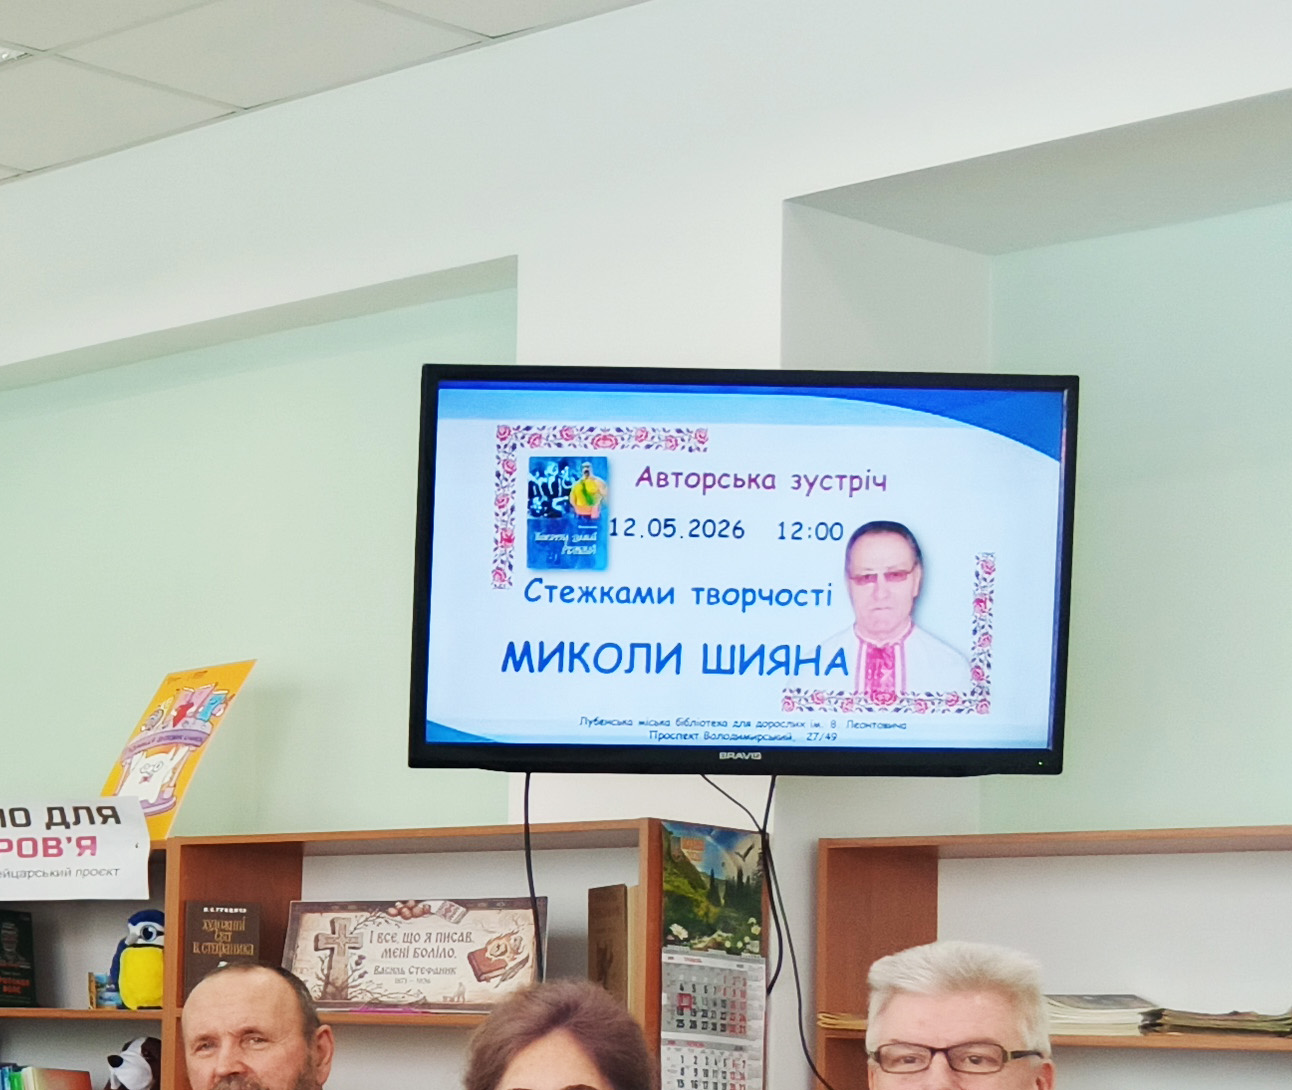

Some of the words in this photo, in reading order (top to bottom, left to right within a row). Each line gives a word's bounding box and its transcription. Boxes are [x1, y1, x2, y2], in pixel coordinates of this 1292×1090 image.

[635, 465, 776, 496] Авторська
[790, 467, 888, 498] зустріч
[609, 518, 745, 541] 12.05.2026
[777, 521, 844, 542] 12:00
[524, 578, 676, 607] Стежками
[691, 582, 833, 611] творчості
[501, 641, 683, 677] МИКОЛИ
[701, 643, 850, 677] ШИЯНА
[649, 730, 699, 741] Проспект
[45, 805, 122, 830] ДЛЯ
[402, 931, 421, 944] ЩО
[424, 932, 432, 943] Я
